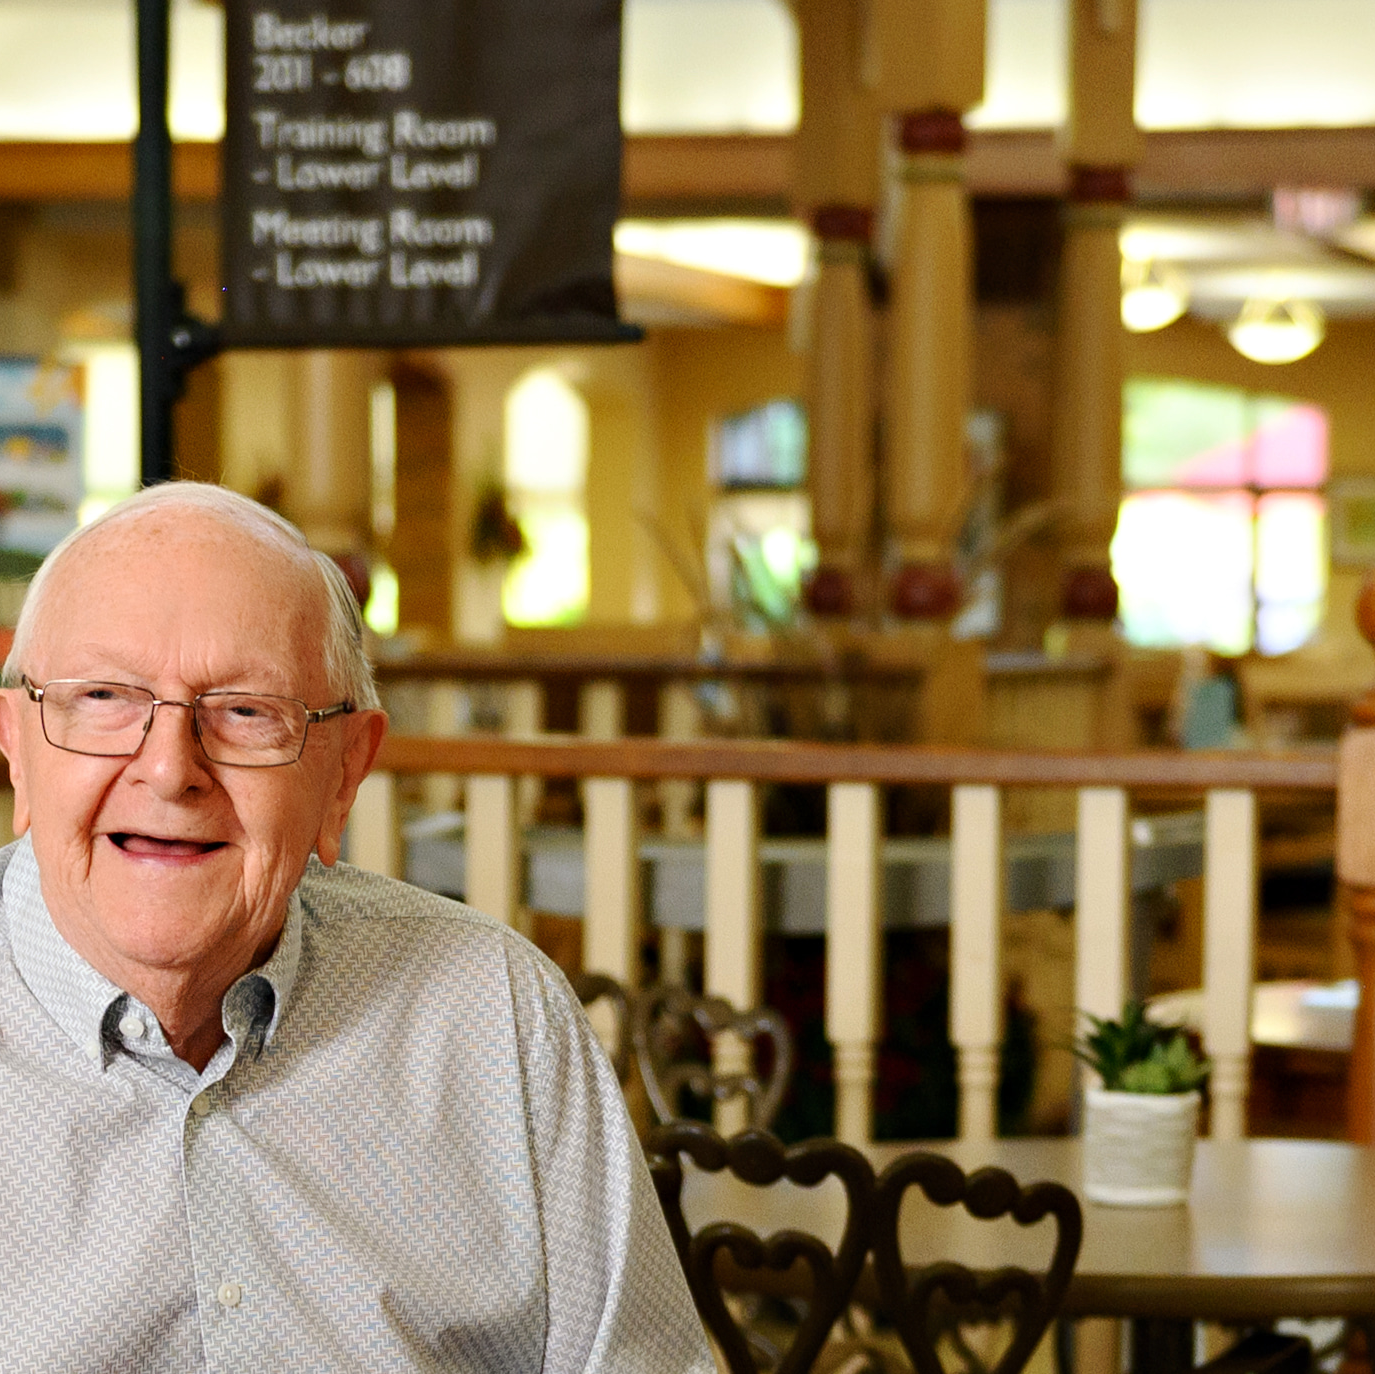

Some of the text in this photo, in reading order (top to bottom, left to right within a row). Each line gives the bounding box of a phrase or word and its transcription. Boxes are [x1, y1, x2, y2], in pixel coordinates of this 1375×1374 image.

[252, 12, 366, 52] Becker
[253, 52, 313, 92] 201
[252, 109, 496, 157] Training Room
[275, 154, 384, 190] Lower
[389, 153, 479, 190] Level
[251, 206, 494, 256] Meeting Room
[274, 251, 381, 289] Lower
[388, 250, 479, 288] Level
